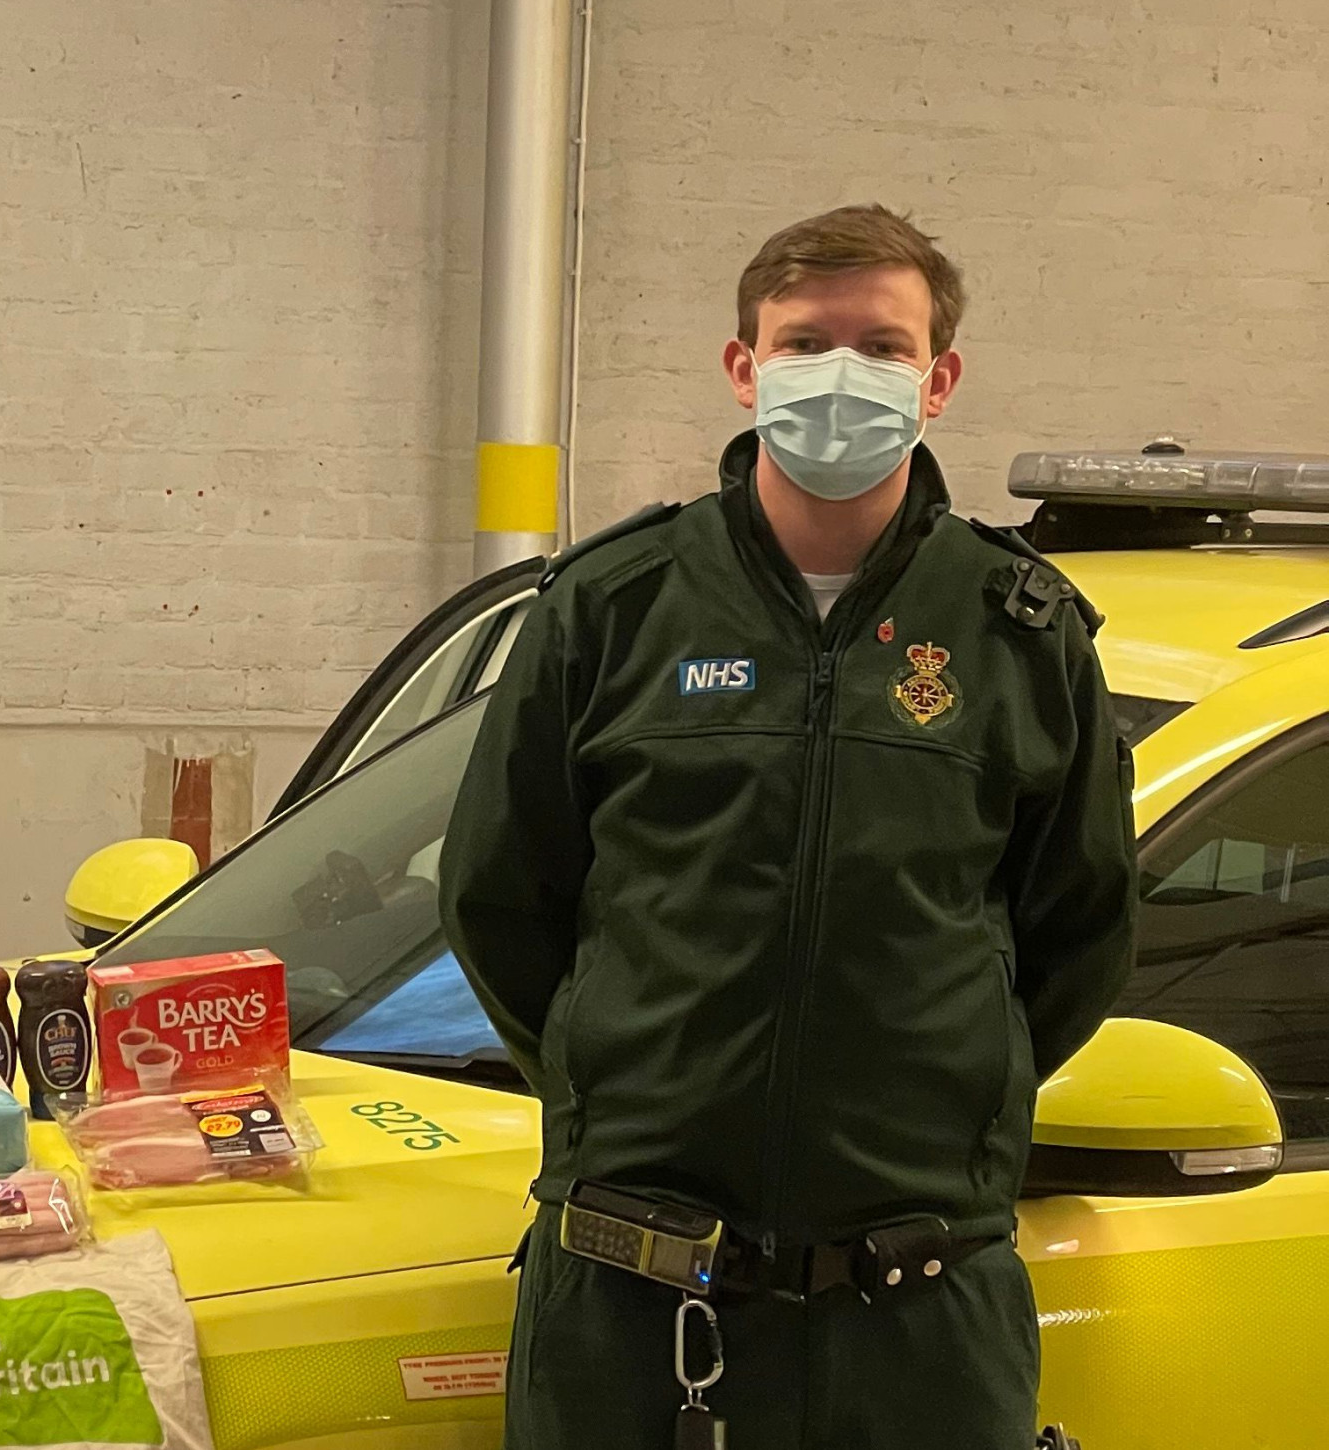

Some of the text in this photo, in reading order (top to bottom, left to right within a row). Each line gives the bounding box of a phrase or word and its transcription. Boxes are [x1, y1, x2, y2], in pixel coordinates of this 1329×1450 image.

[685, 660, 750, 691] NHS
[157, 987, 268, 1030] BARRY'S
[182, 1023, 241, 1053] TEA
[195, 1054, 235, 1070] GOLD
[350, 1101, 461, 1151] 8275
